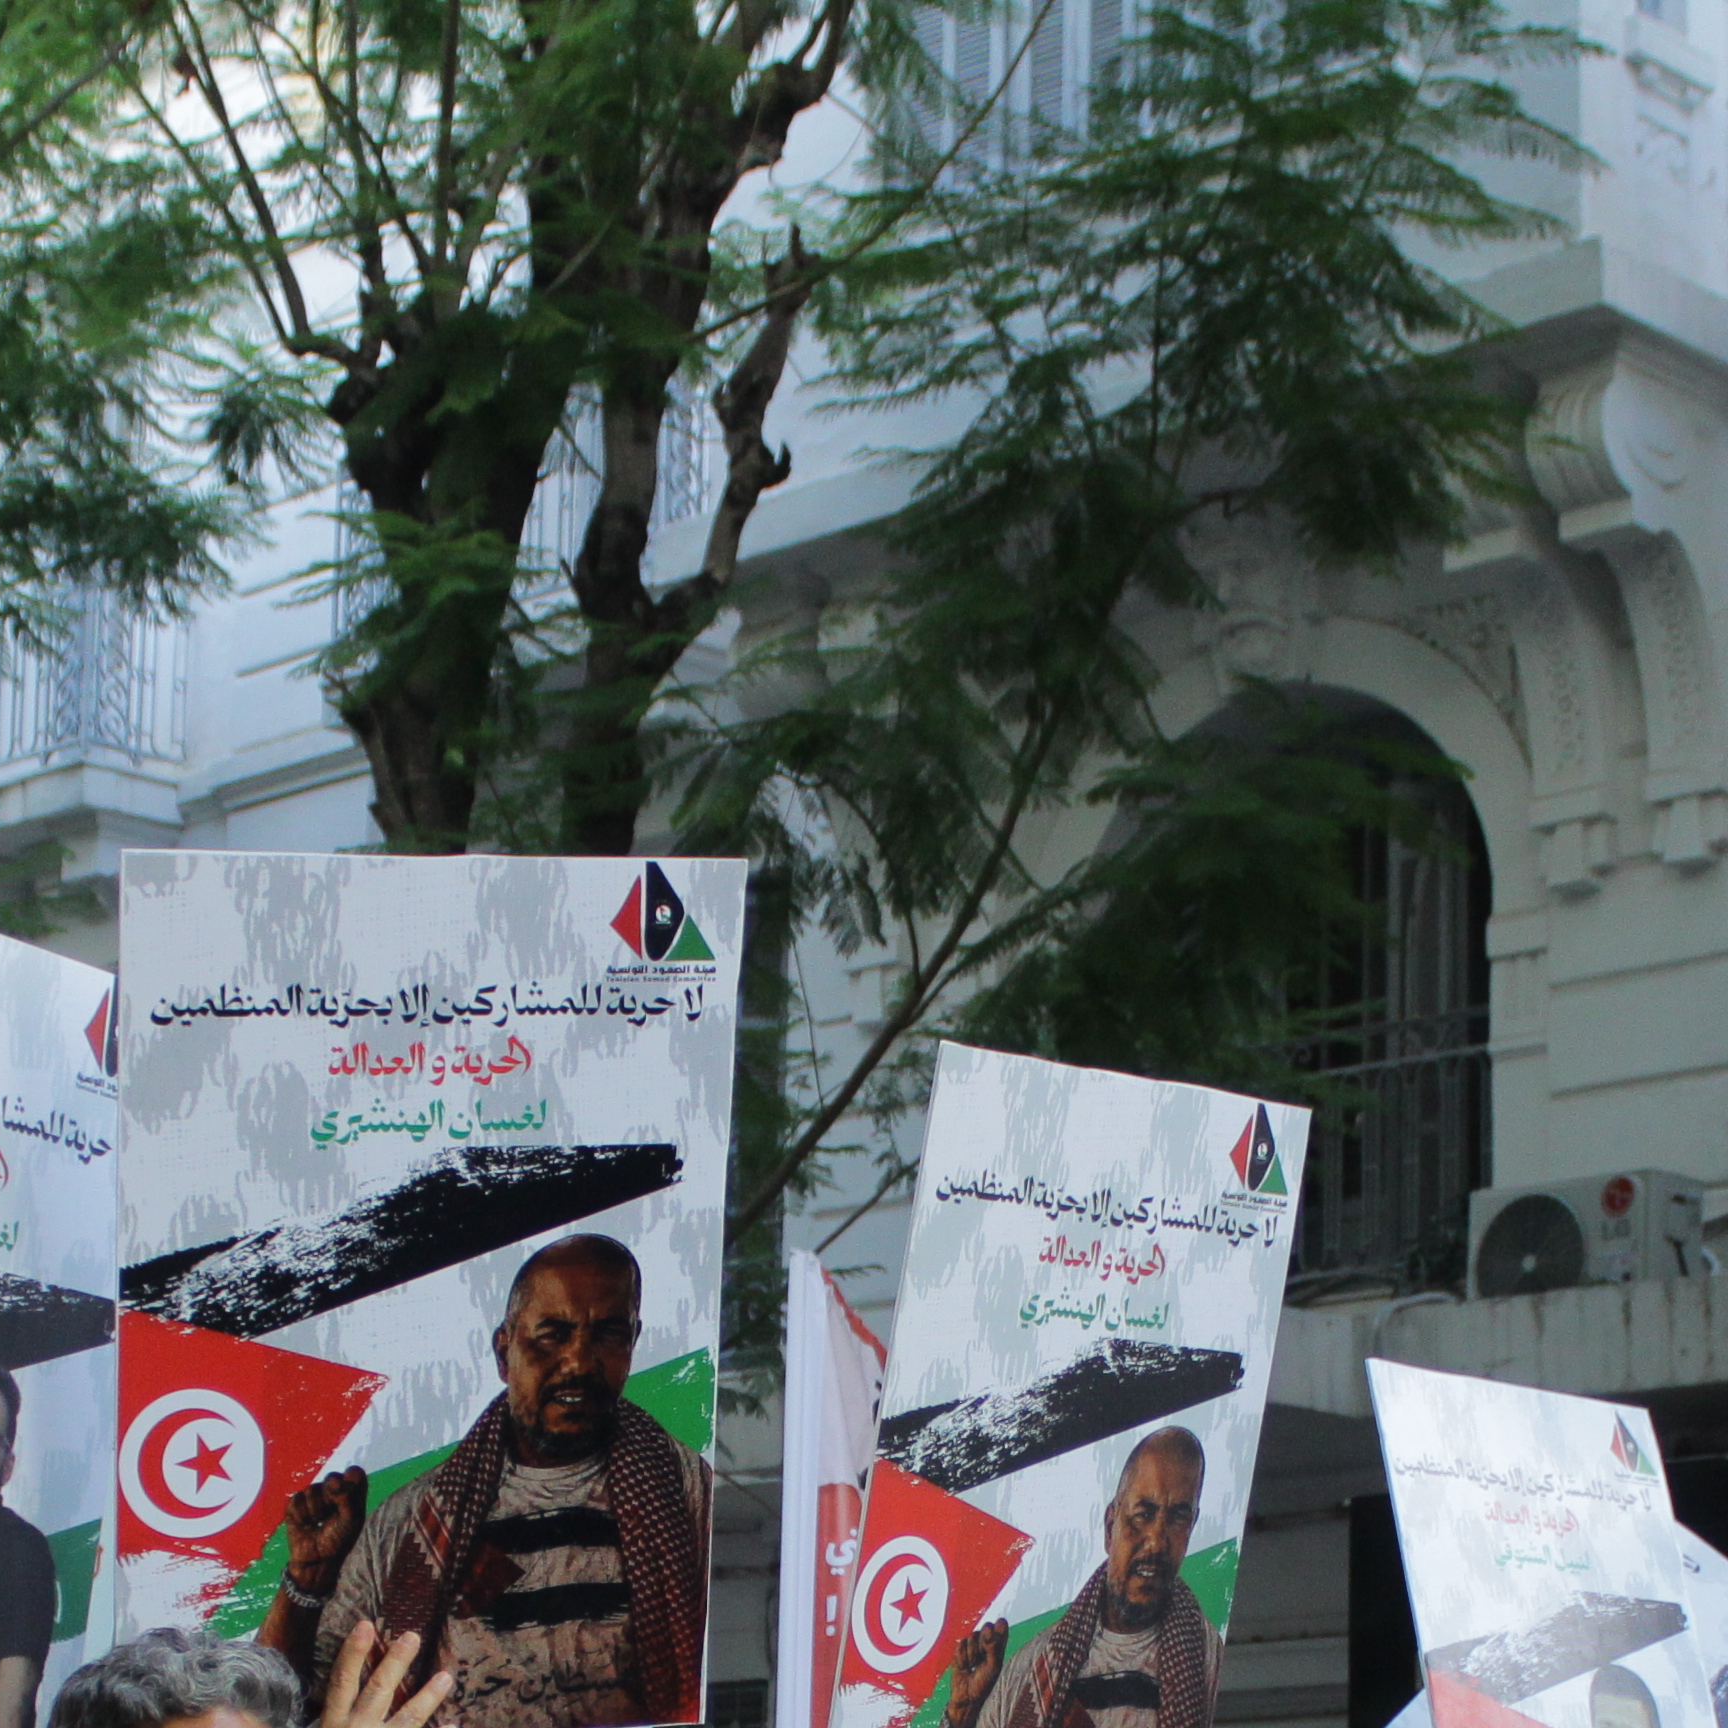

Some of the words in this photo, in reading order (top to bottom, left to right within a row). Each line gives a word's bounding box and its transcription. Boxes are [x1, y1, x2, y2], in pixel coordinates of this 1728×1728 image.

[150, 981, 303, 1026] المنظمين
[402, 982, 432, 1027] إلا
[433, 981, 602, 1026] للمشاركين
[612, 988, 676, 1026] حرية
[686, 985, 703, 1022] لا
[328, 1042, 425, 1077] العدالة
[432, 1054, 446, 1086] و
[452, 1035, 532, 1085] الحرية
[310, 1096, 444, 1150] الهنشيري
[448, 1098, 547, 1141] لغسان
[65, 1119, 112, 1164] حرية
[936, 1169, 1035, 1206] المنظمين
[1091, 1187, 1111, 1229] إلا
[1110, 1195, 1218, 1236] للمشاركين
[1217, 1209, 1259, 1248] حرية
[1263, 1213, 1278, 1248] لا
[1039, 1233, 1101, 1267] العدالة
[1101, 1254, 1112, 1281] و
[1115, 1242, 1166, 1285] الحرية
[1019, 1287, 1105, 1330] الهنشيري
[1105, 1295, 1169, 1331] لغسان
